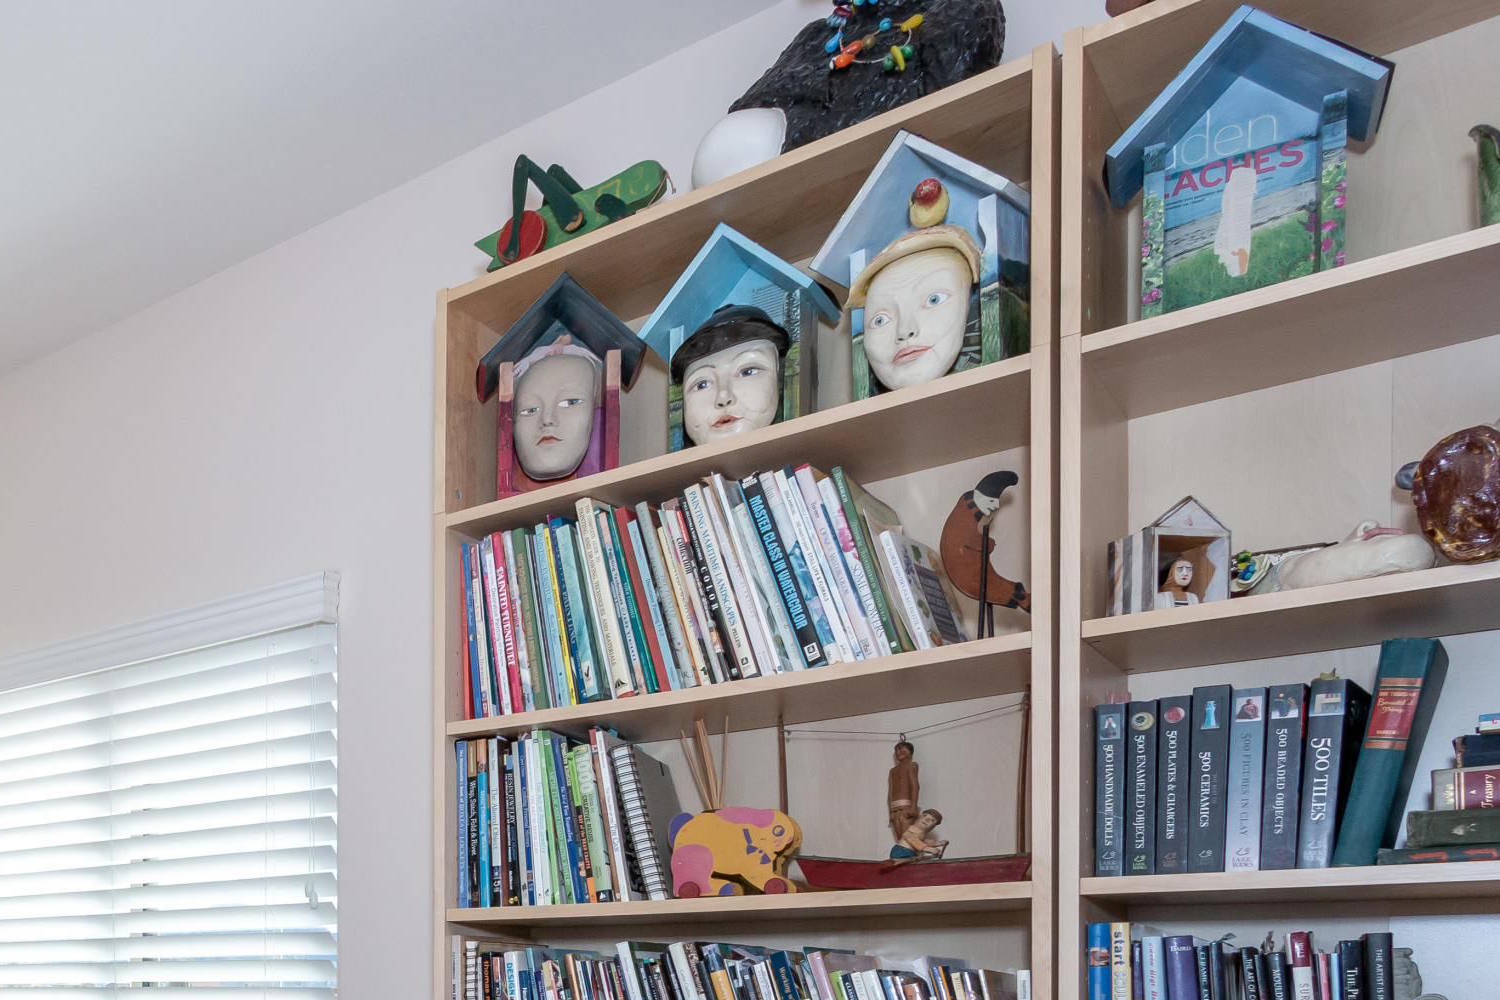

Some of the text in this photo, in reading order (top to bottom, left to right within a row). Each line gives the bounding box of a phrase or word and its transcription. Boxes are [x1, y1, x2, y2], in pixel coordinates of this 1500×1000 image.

[1165, 140, 1303, 198] ACHES
[688, 490, 737, 626] PAINTING MARITIME LANDSCAPES
[749, 495, 808, 630] MASTER CLASS IN WATERCOLOR
[1103, 744, 1115, 846] 500 HANDMADE DOLLS
[1132, 734, 1146, 849] 500 ENAMELED OBJECTS
[1198, 751, 1211, 828] 500 CERAMICS
[1273, 728, 1287, 834] 500 BEADED OBJECTS
[1310, 738, 1330, 821] 500 TILES
[506, 962, 516, 996] DESIGN
[778, 966, 793, 994] Working
[1113, 931, 1125, 966] start
